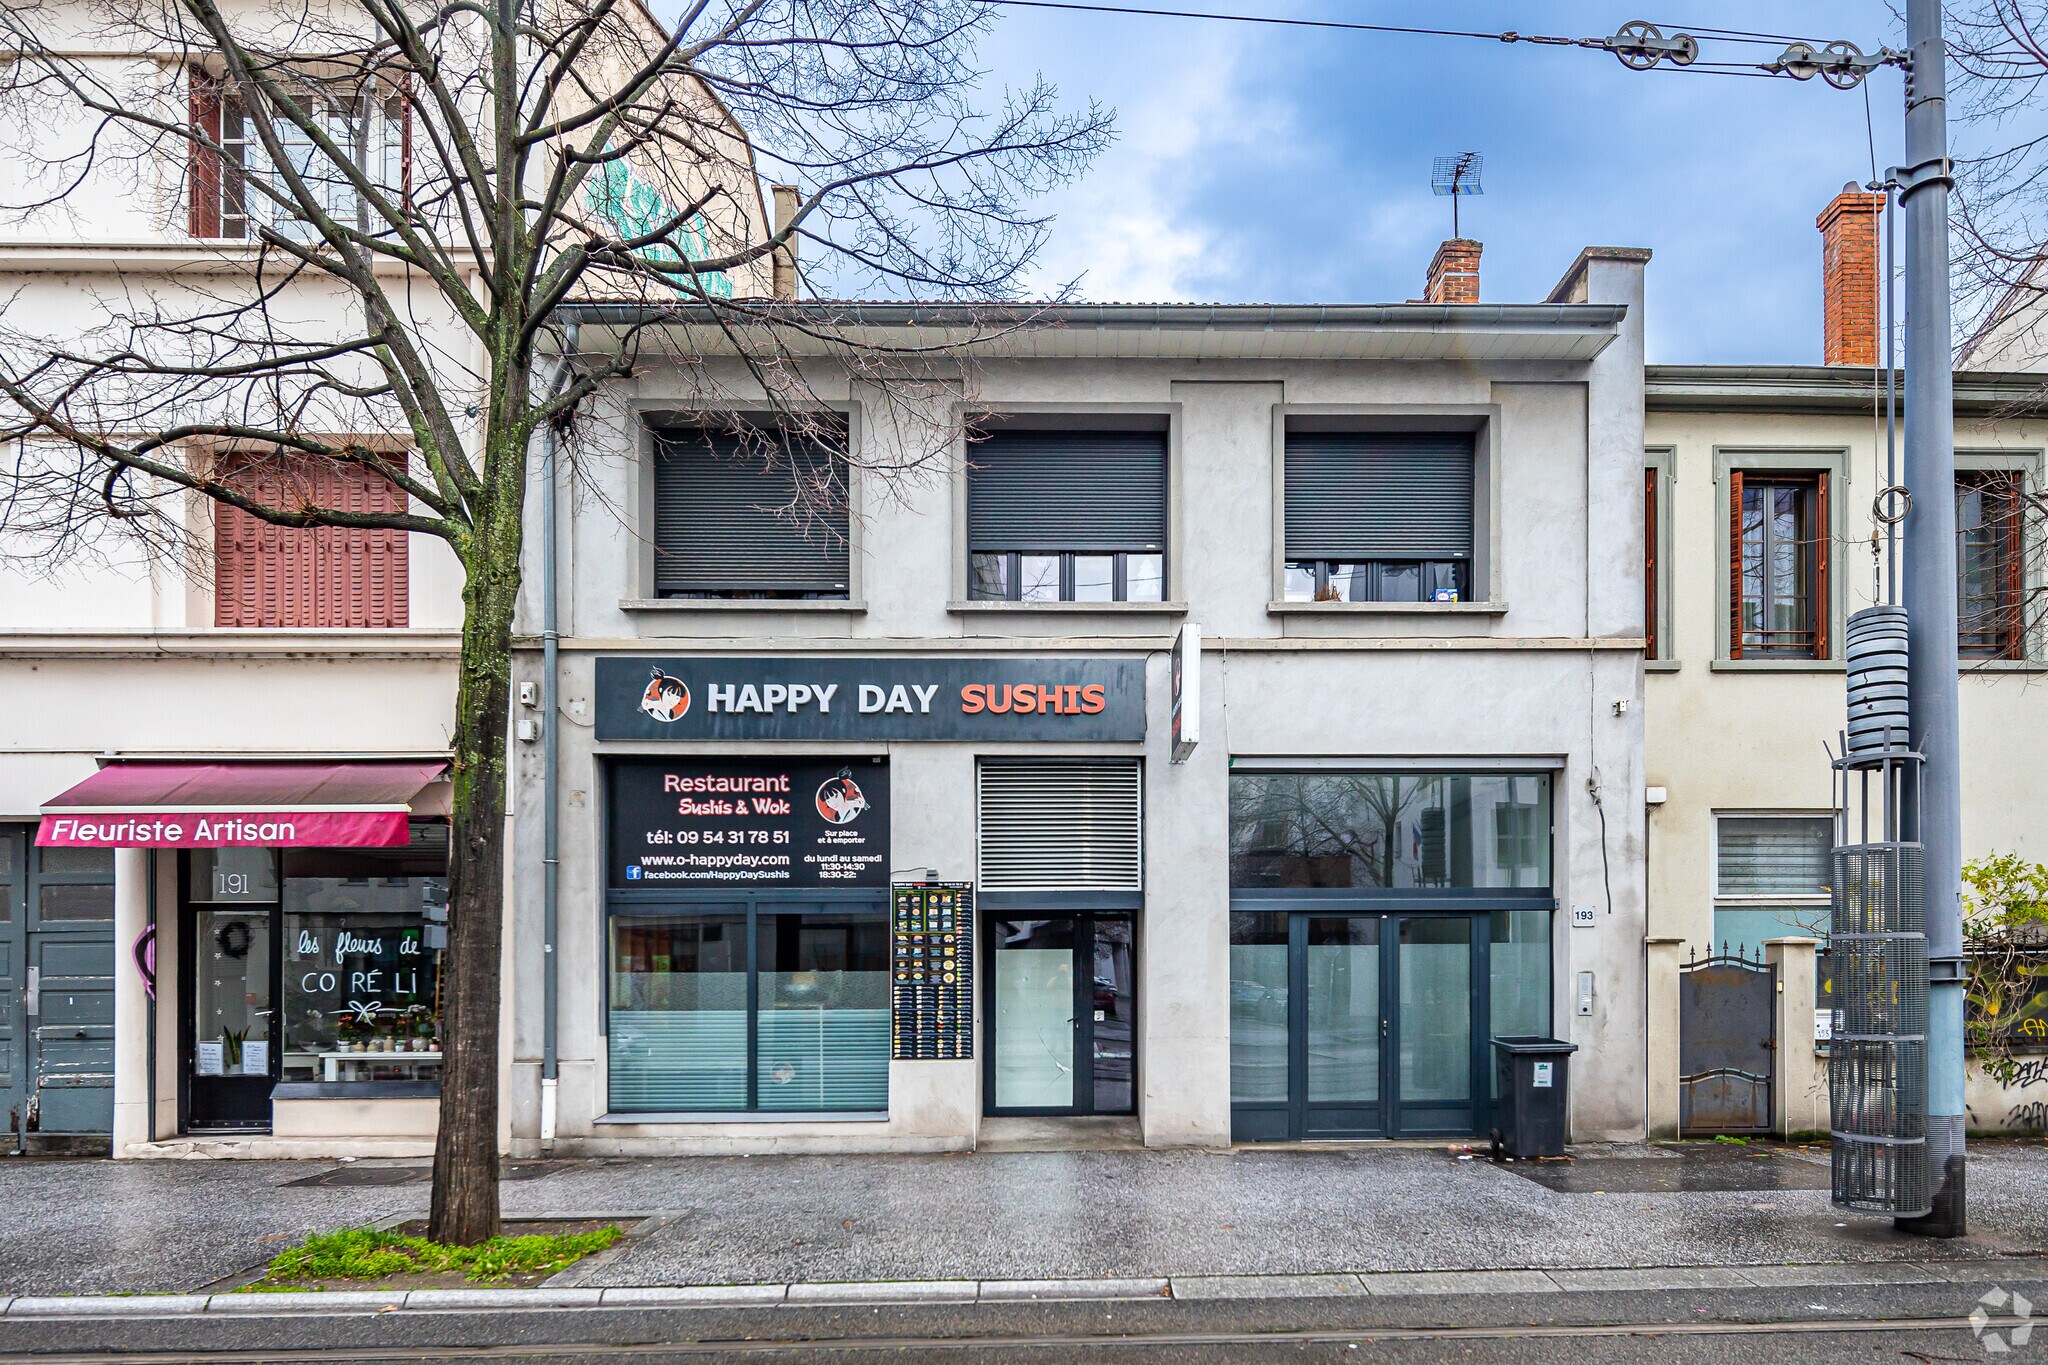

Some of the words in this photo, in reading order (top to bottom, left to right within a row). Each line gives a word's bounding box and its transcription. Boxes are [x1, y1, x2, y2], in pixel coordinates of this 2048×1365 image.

[706, 683, 838, 714] HAPPY
[858, 683, 939, 714] DAY
[960, 683, 1106, 714] SUSHIS
[664, 774, 791, 793] Restaurant
[678, 797, 733, 816] Sushis
[735, 799, 749, 815] &
[752, 797, 791, 815] Wok
[51, 819, 183, 841] Fleuriste
[193, 818, 295, 841] Artisan
[824, 829, 838, 837] Sur
[838, 829, 858, 838] place
[646, 830, 673, 845] tél:
[677, 831, 699, 844] 09
[702, 831, 724, 844] 54
[727, 831, 744, 844] 31
[748, 831, 769, 844] 78
[772, 831, 790, 844] 51
[827, 837, 833, 845] à
[641, 854, 790, 868] www.o-happyday.com
[804, 855, 816, 863] du
[816, 855, 838, 863] lundi
[851, 855, 882, 863] samedi
[821, 863, 865, 871] 11:30-14:30
[644, 870, 790, 881] facebook.com/HappyDaySushis
[219, 873, 250, 894] 191
[1575, 911, 1593, 920] 193
[297, 930, 320, 954] les
[335, 932, 382, 965] fleurs
[400, 936, 420, 955] de
